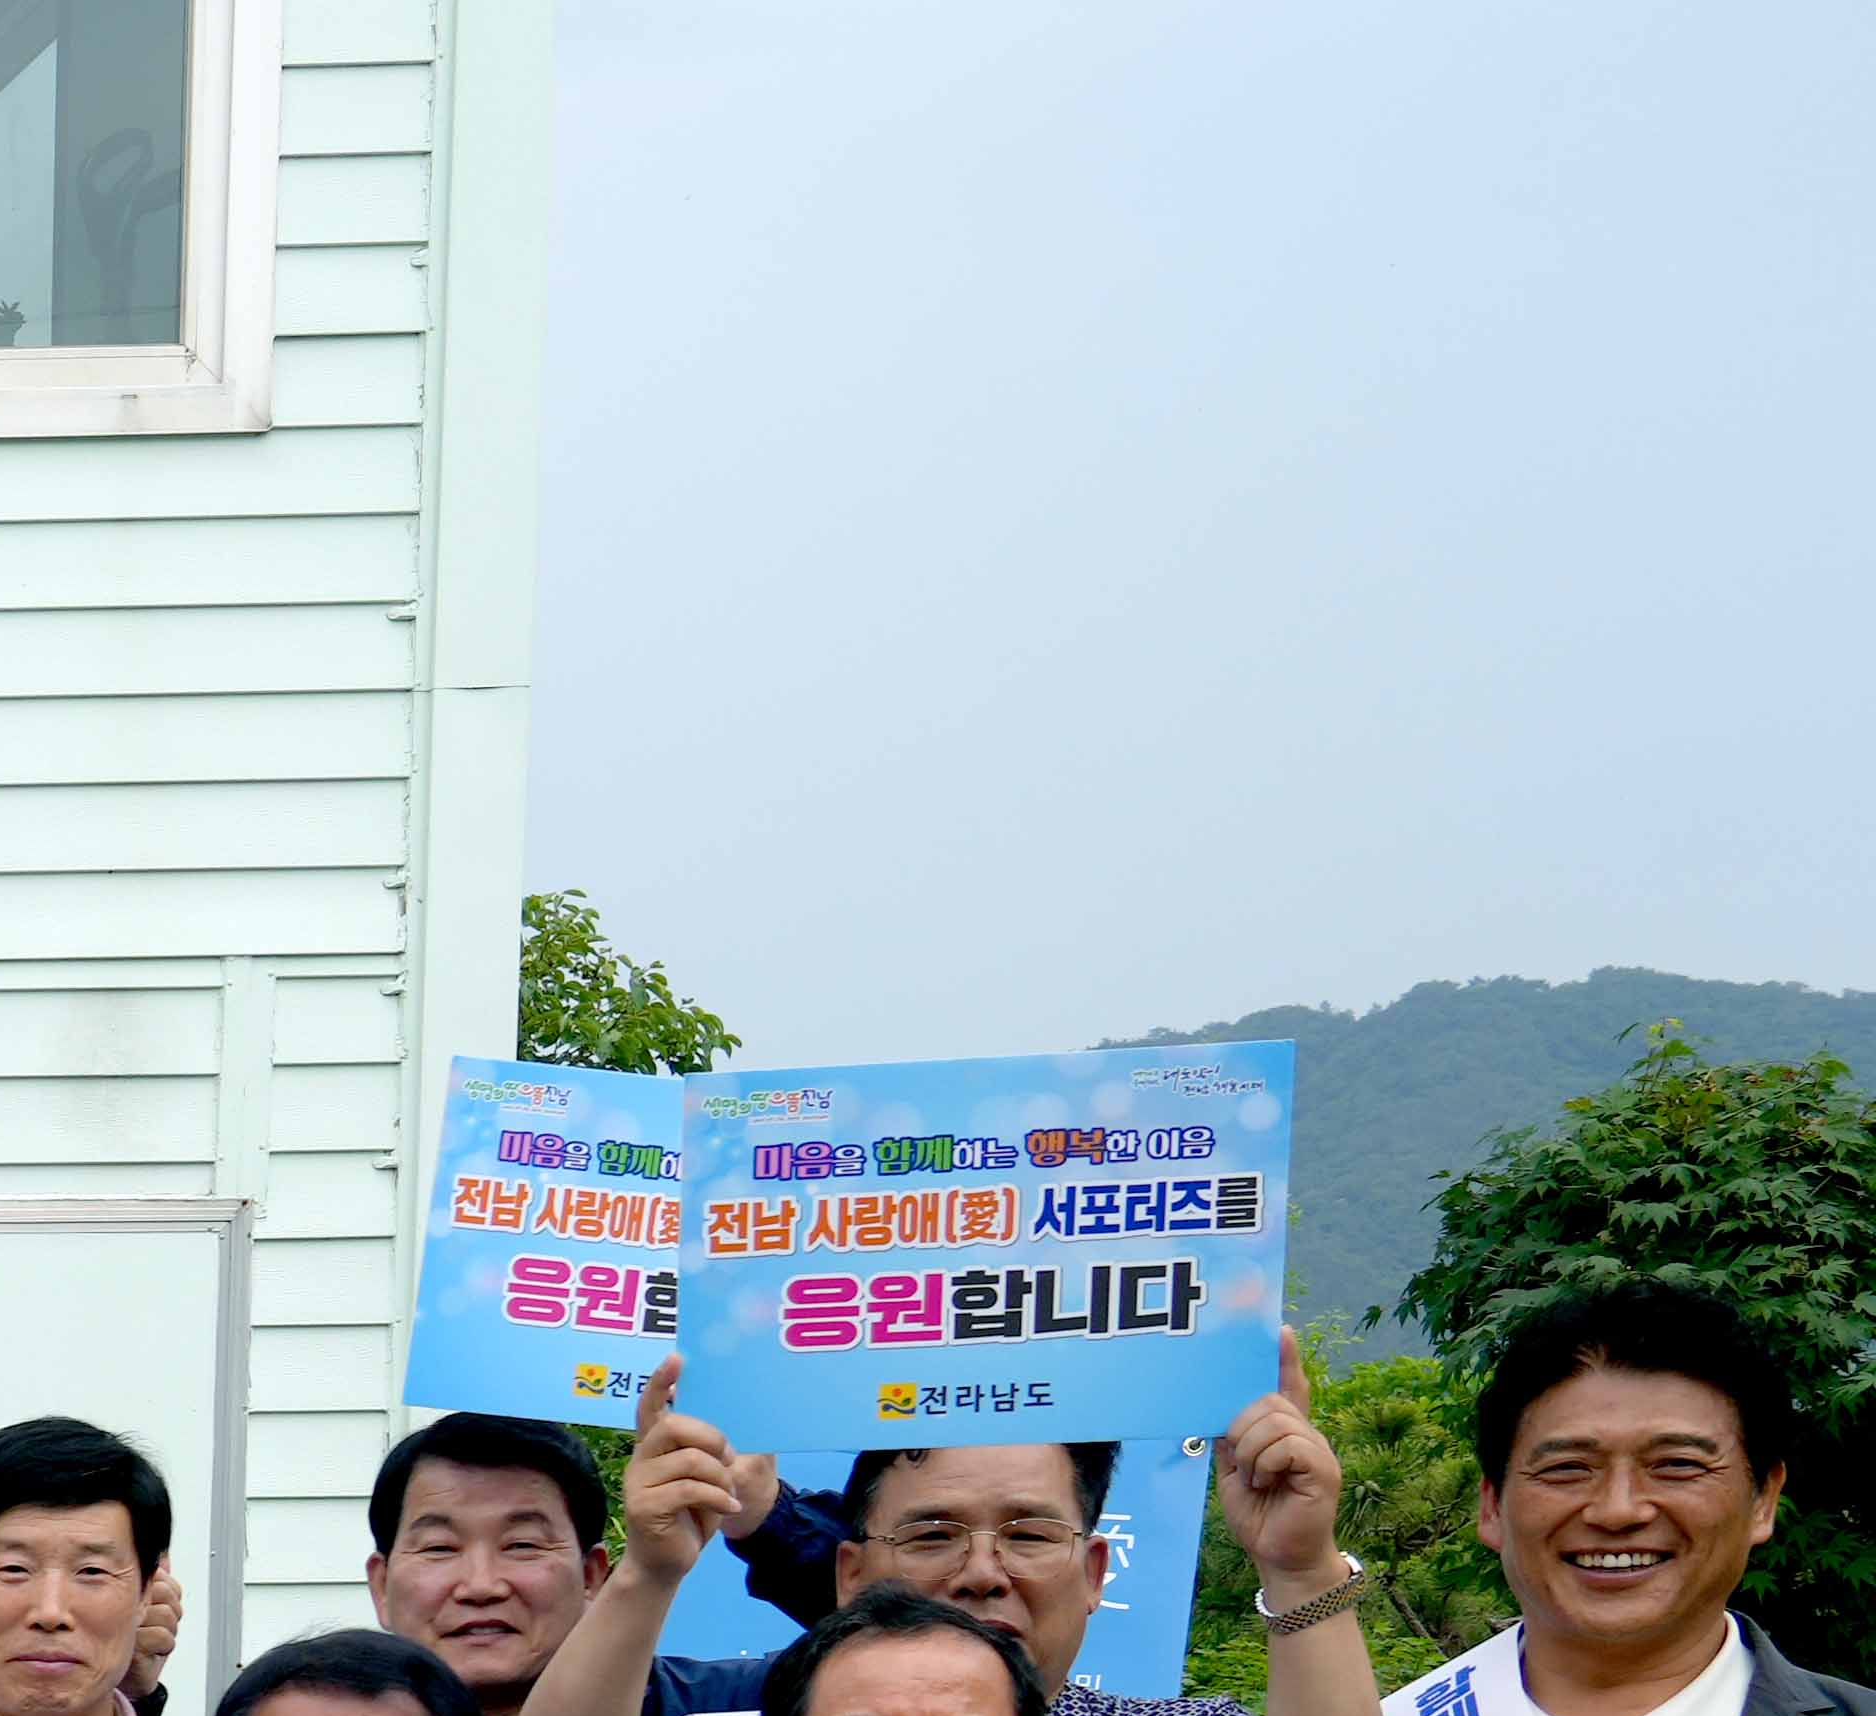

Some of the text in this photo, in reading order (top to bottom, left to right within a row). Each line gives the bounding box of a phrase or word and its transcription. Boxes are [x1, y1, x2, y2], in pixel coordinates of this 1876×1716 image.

[497, 1130, 591, 1169] 마음을
[753, 1127, 1214, 1180] 마음을 함께하는 행복한 이음
[452, 1178, 523, 1227] 전남
[706, 1173, 1263, 1256] 전남 사랑애(愛) 서포터즈를
[780, 1259, 1205, 1350] 응원합니다
[920, 1381, 1053, 1414] 전라남도
